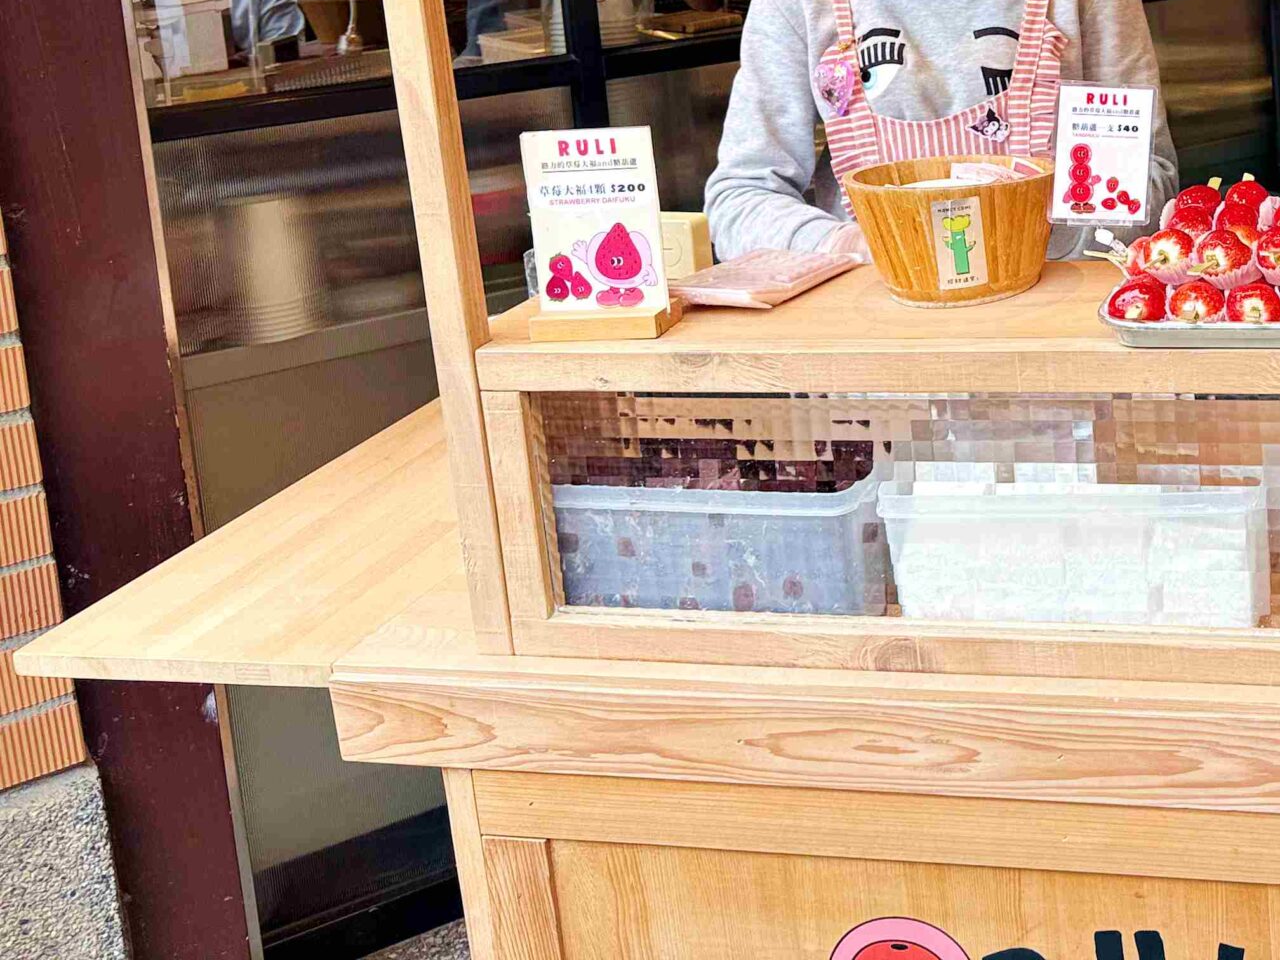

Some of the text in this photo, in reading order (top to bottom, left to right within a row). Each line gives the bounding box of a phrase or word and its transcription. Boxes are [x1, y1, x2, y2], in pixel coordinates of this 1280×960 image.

[1086, 93, 1127, 106] RULI
[1117, 124, 1139, 132] $40
[558, 138, 616, 156] RULI
[611, 183, 646, 193] $200
[549, 196, 636, 206] STRAWBERRY DAIFUKU
